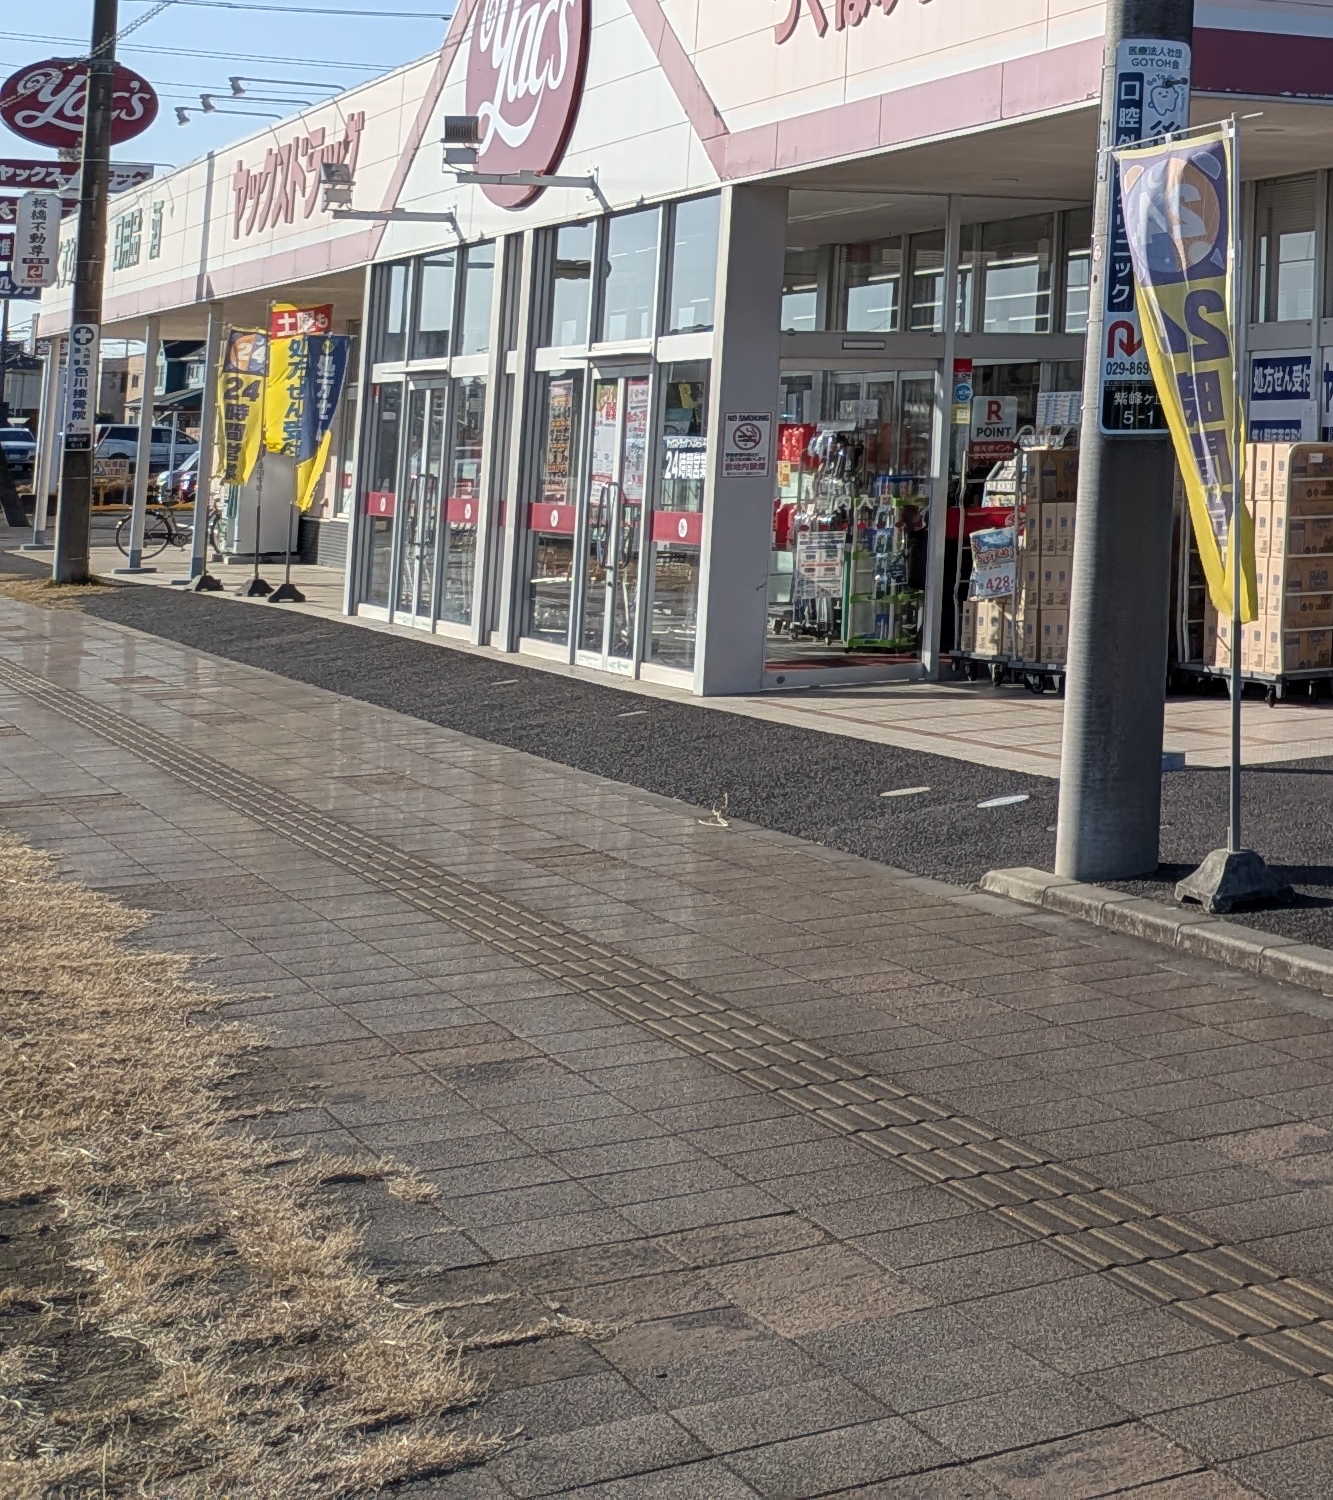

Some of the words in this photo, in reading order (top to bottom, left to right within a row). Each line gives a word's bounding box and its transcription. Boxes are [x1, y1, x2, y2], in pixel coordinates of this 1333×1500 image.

[1128, 46, 1183, 59] 医療法人社団
[1131, 58, 1180, 70] GOTOH会
[28, 197, 48, 258] 板橋不動尊
[976, 426, 1013, 438] POINT
